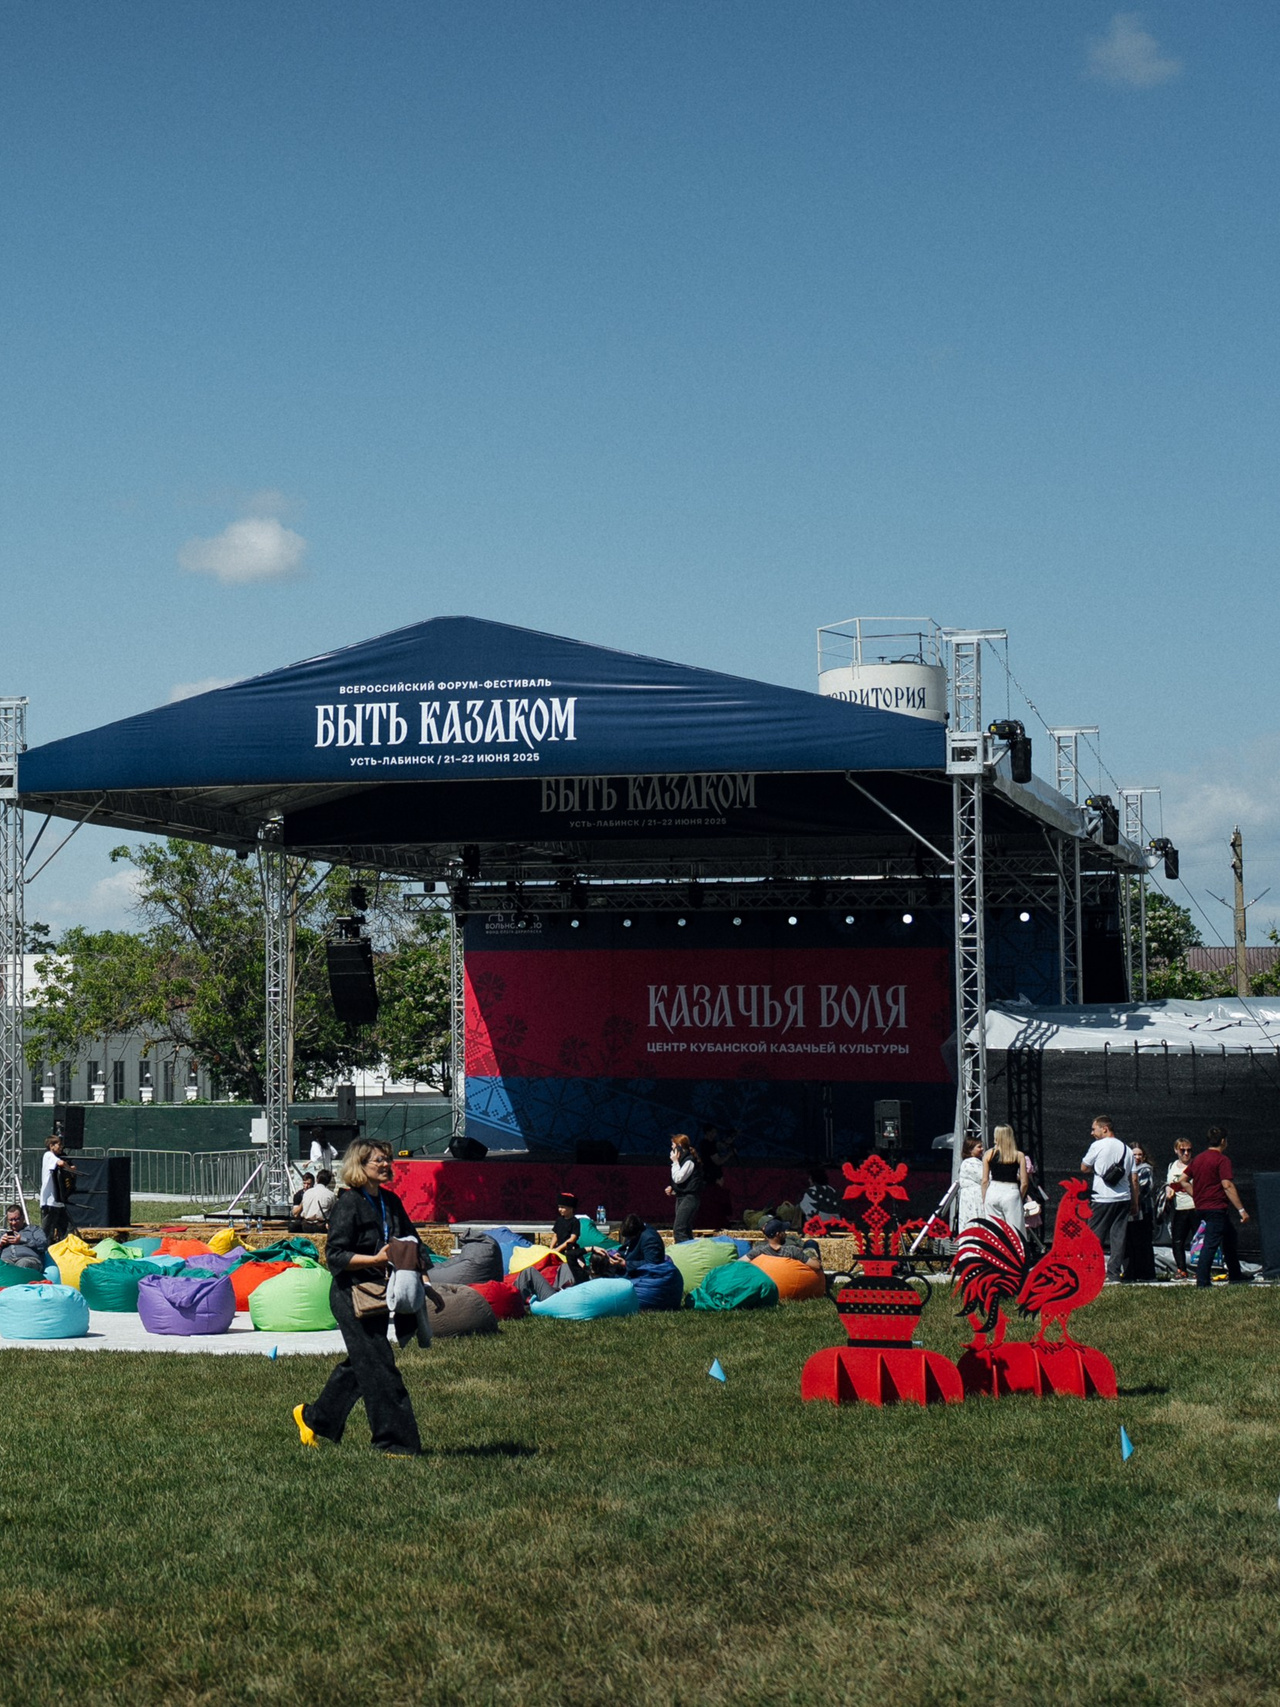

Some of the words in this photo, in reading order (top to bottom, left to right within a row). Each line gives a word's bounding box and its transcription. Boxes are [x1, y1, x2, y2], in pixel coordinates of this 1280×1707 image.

[339, 680, 435, 695] ВСЕРОССИЙСКИЙ
[437, 678, 552, 691] ФОРУМ-ФЕСТИВАЛЬ
[826, 687, 926, 711] РИТОРИЯ
[314, 702, 408, 748] БЫТЬ
[418, 697, 578, 750] КАЗАКОМ
[349, 755, 435, 767] УСТЬ-ЛАБИНСК
[476, 753, 510, 763] ИЮНЯ
[512, 752, 540, 762] 2025
[540, 779, 618, 813] БЫТЬ
[626, 774, 758, 815] КАЗАКОМ
[569, 819, 640, 828] УСТЬ-ЛАБИНСК
[674, 818, 703, 826] ИЮНЯ
[704, 817, 727, 826] 2025
[485, 922, 518, 930] ВОЛЬНО
[647, 984, 806, 1035] КАЗАЧЬЯ
[818, 984, 908, 1035] ВОЛЯ
[646, 1042, 688, 1053] ЦЕНТР
[690, 1041, 767, 1053] КУБАНСКОЙ
[770, 1041, 836, 1054] КАЗАЧЬЕЙ
[839, 1043, 910, 1054] КУЛЬТУРЫ
